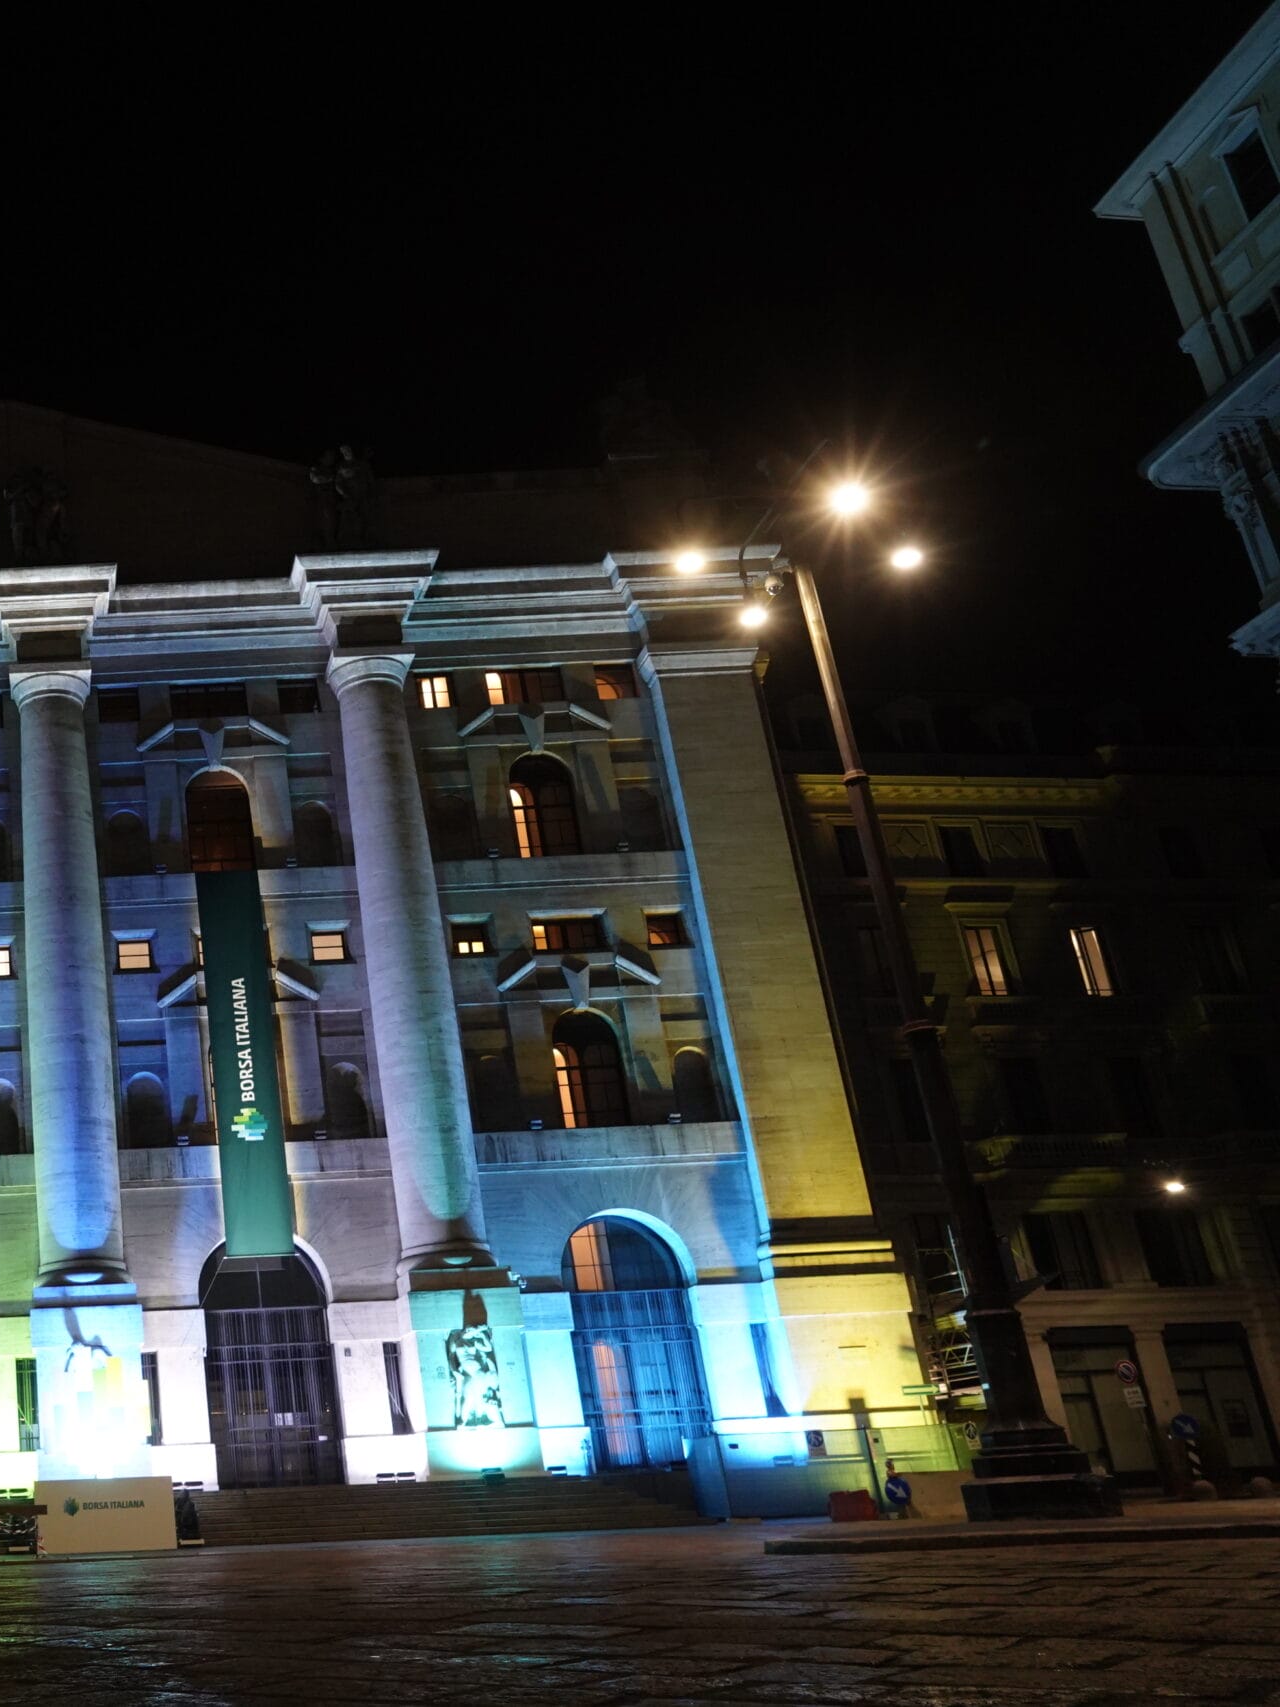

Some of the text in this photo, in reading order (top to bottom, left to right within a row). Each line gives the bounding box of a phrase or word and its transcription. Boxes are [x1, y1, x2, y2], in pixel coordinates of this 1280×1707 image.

[231, 977, 255, 1102] BORSA ITALIANA
[82, 1499, 145, 1511] BORSA ITALIANA
